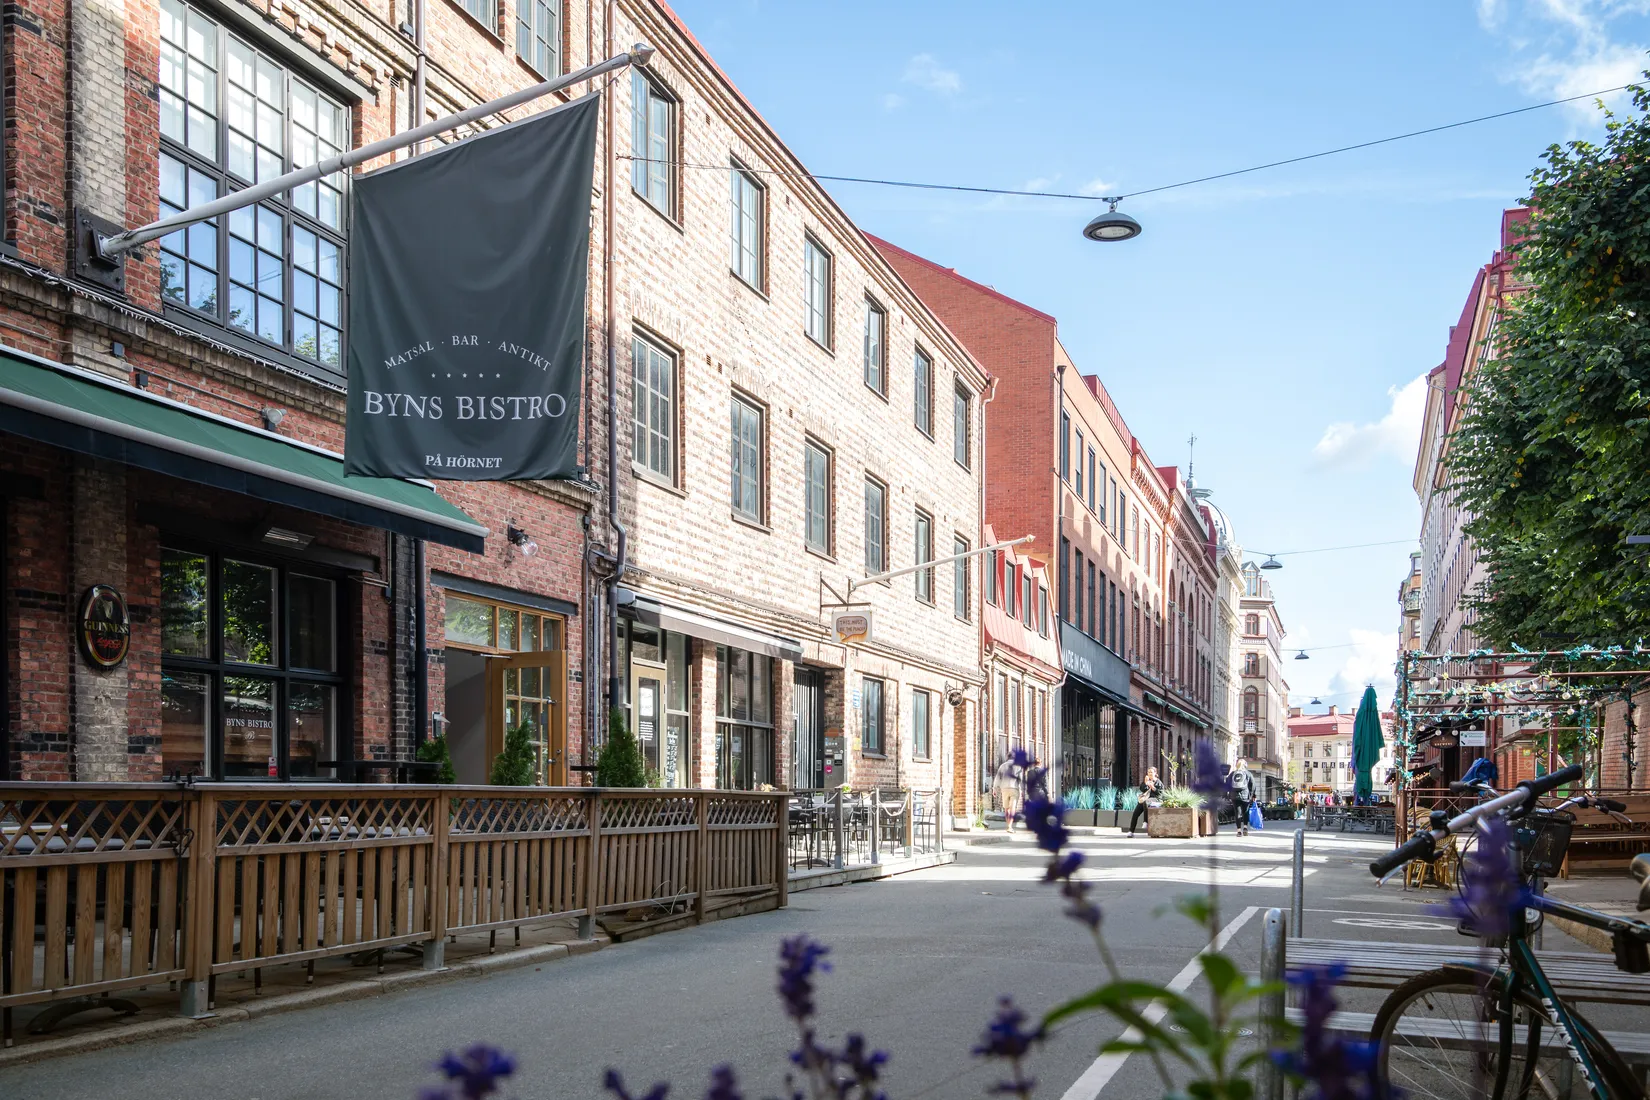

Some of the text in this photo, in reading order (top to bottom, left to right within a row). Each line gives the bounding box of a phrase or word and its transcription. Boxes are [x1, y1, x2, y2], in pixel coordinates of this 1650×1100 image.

[384, 335, 552, 372] MATSAL BAR ANTIKT
[364, 390, 567, 420] BYNS BISTRO
[425, 453, 503, 468] PÅ HÖRNET
[84, 620, 129, 634] GUINNESS
[1080, 656, 1092, 679] CHINA
[226, 718, 274, 729] BYNS BISTRO
